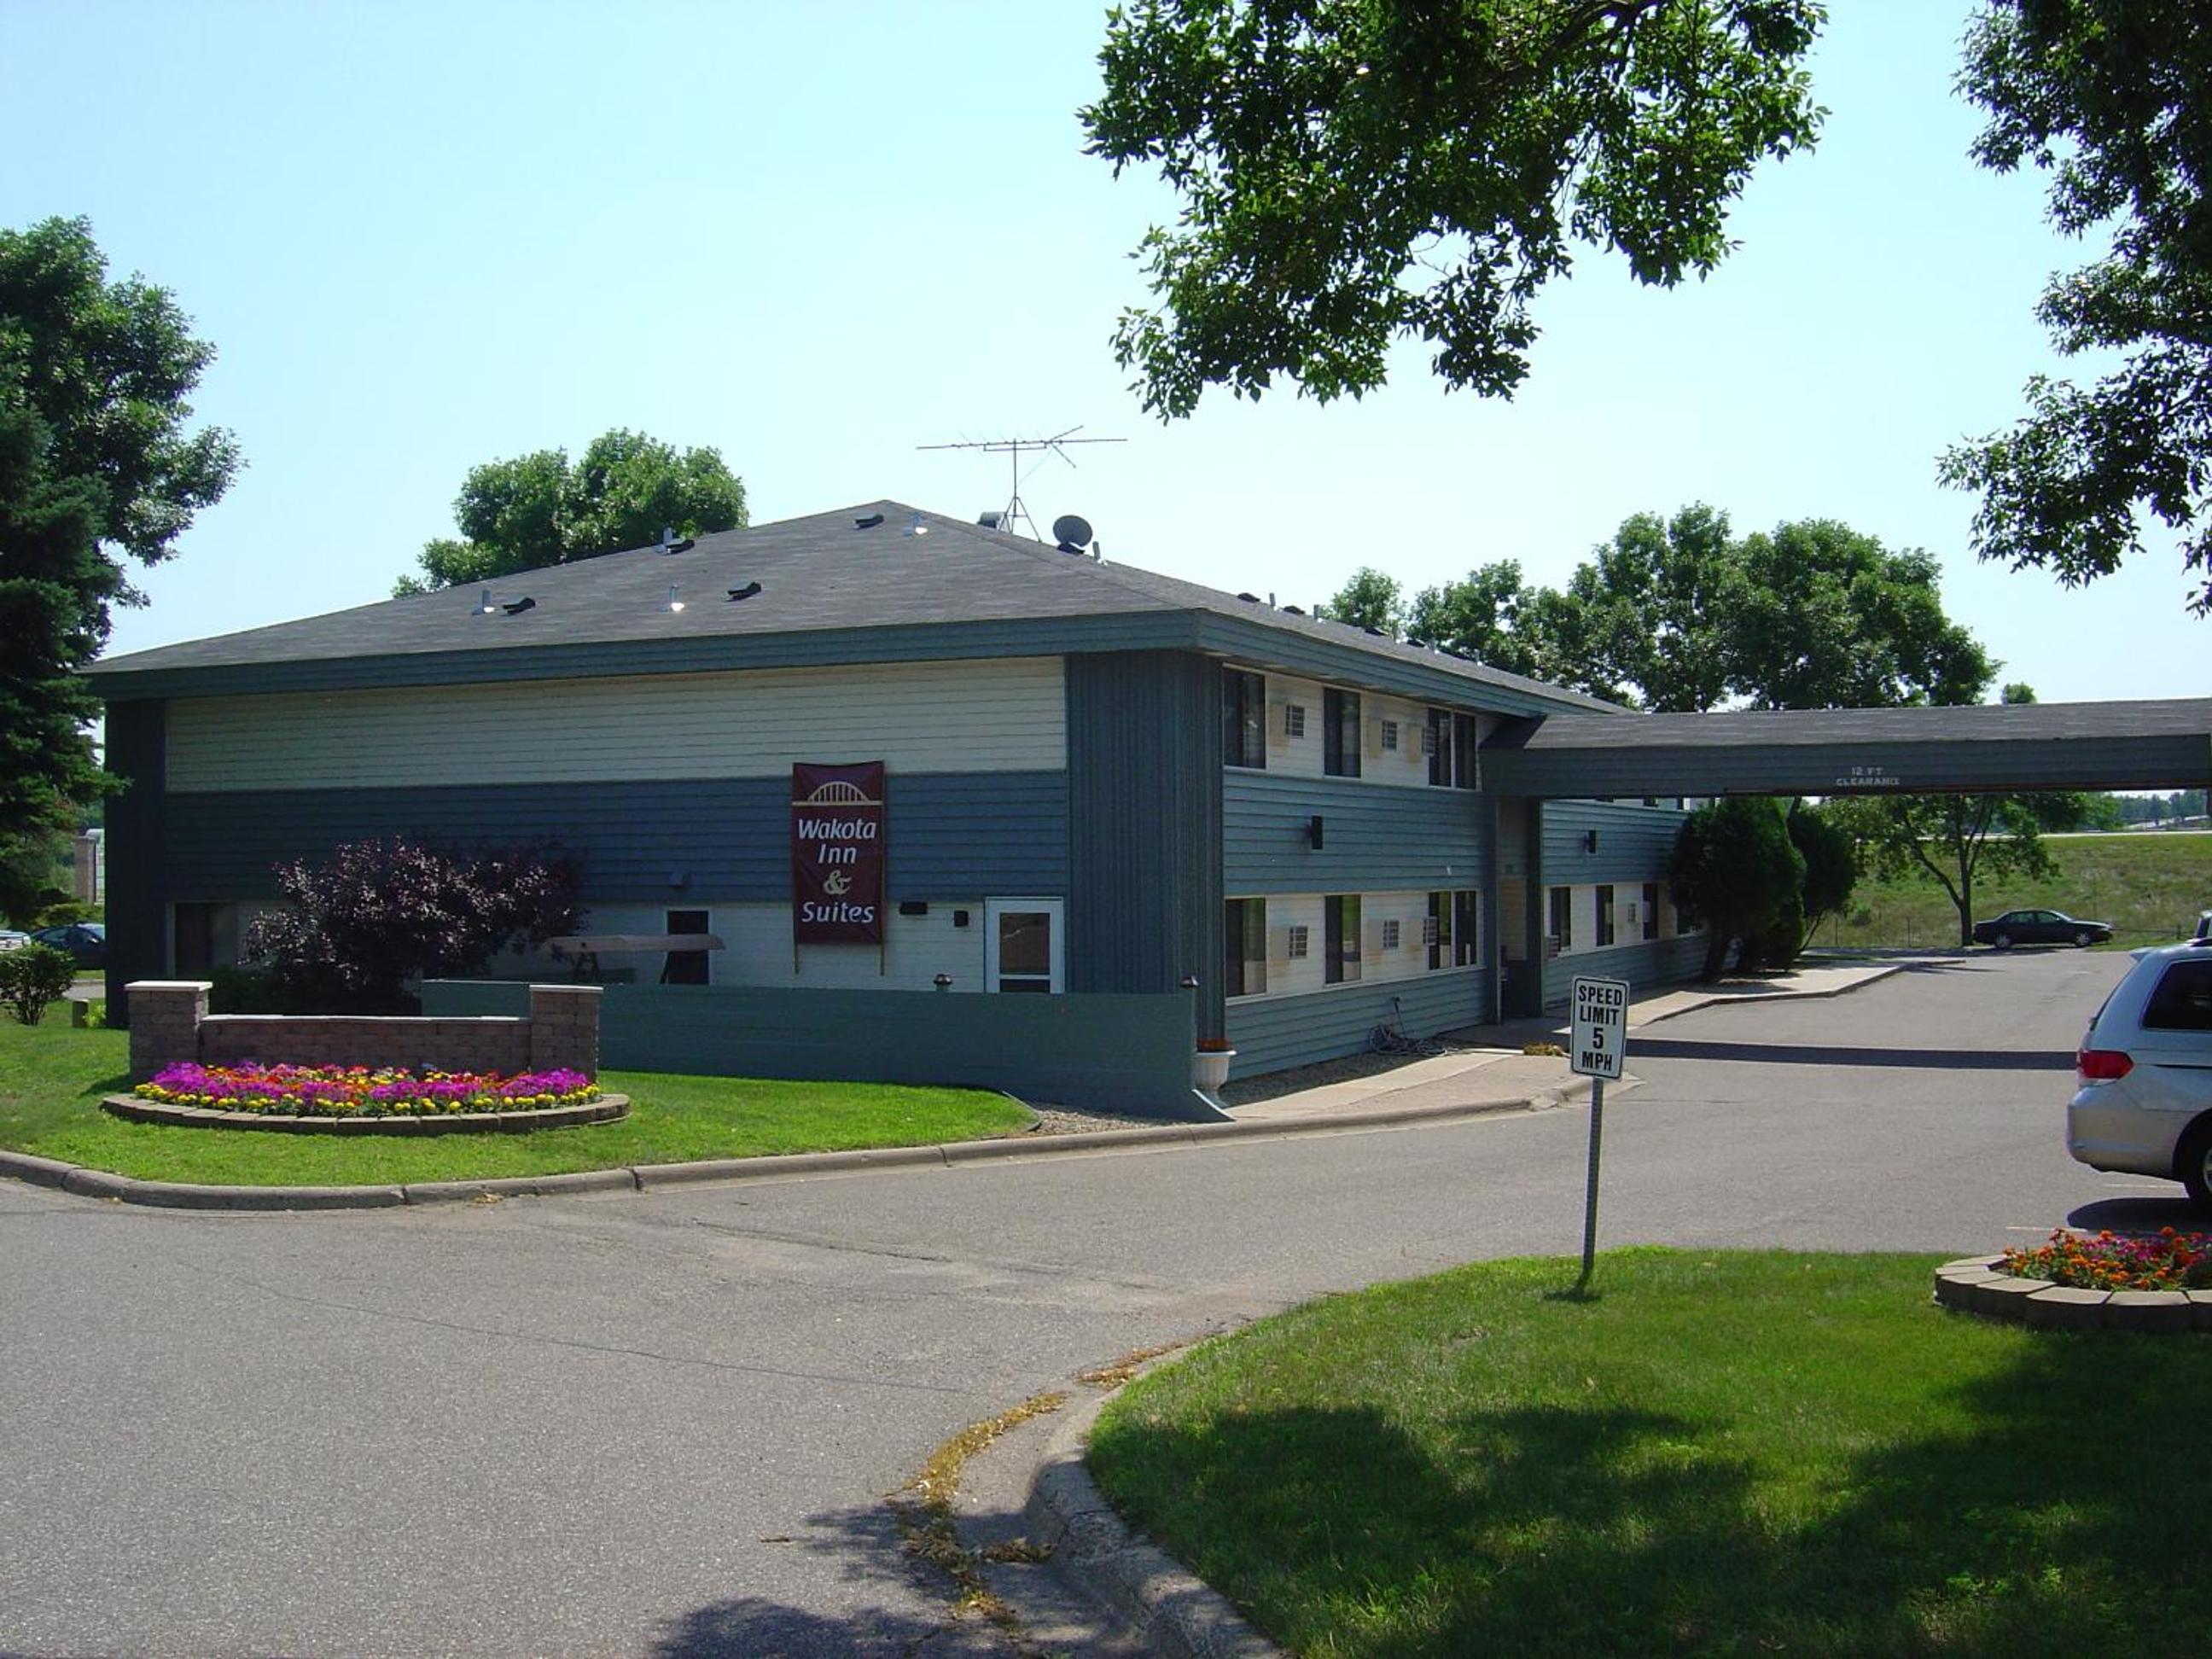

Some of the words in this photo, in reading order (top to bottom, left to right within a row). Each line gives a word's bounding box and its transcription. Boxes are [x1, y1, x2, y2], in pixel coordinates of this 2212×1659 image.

[1836, 777, 1900, 786] CLEARANCE
[798, 818, 876, 840] Wakota
[818, 843, 857, 864] Inn
[824, 870, 852, 895] &
[801, 901, 875, 923] Suites
[1578, 985, 1622, 1006] SPEED
[1580, 1004, 1620, 1026] LIMIT
[1592, 1027, 1604, 1050] 5
[1581, 1051, 1612, 1072] MPH
